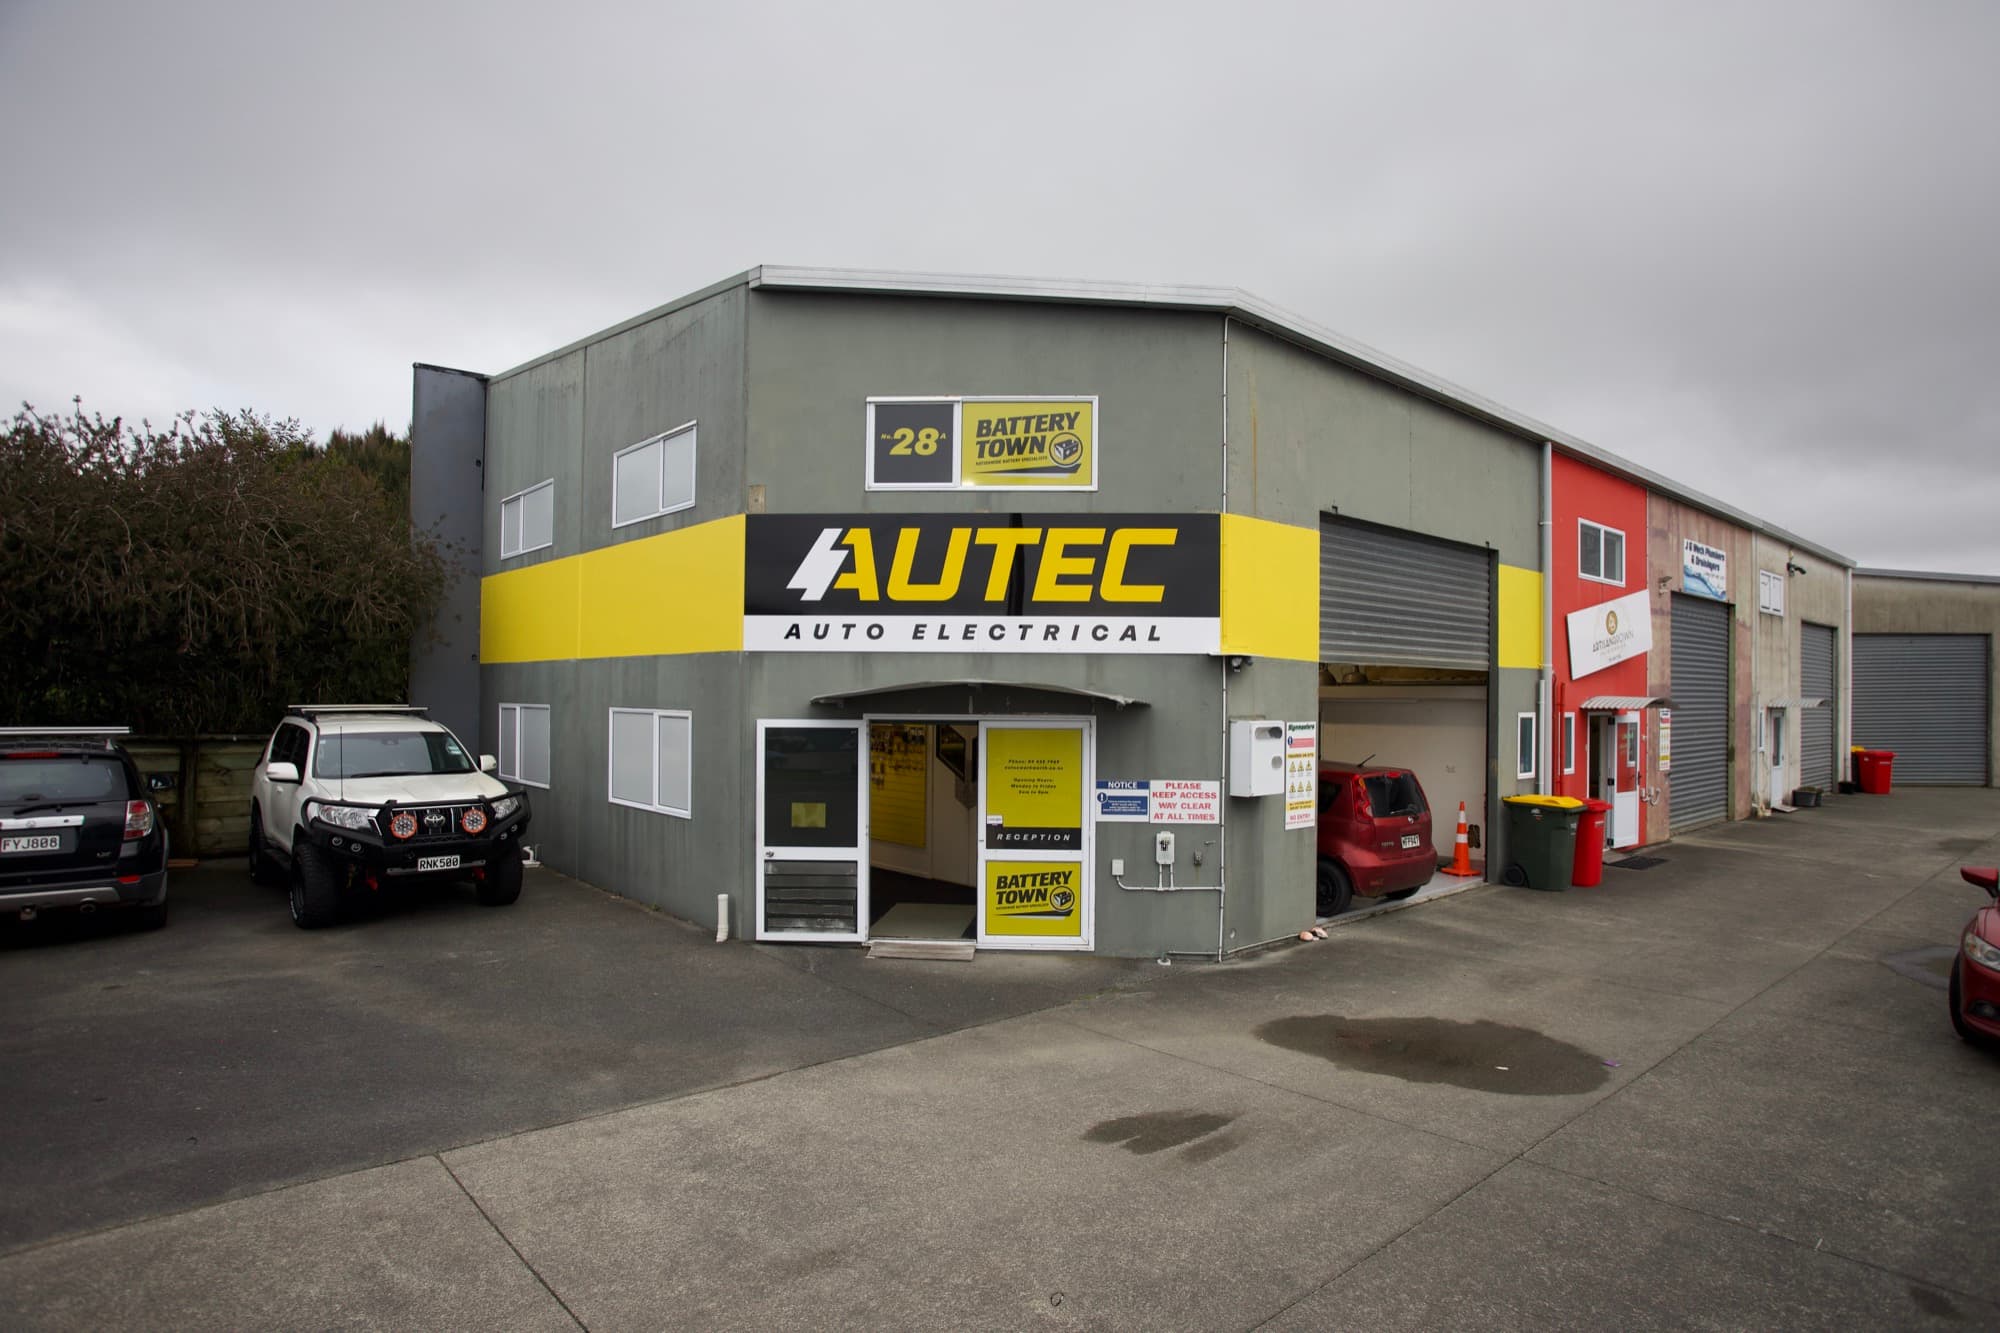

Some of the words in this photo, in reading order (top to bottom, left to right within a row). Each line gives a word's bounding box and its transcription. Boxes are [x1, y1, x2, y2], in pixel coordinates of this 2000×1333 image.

[976, 411, 1080, 438] BATTERY
[976, 436, 1046, 459] TOWN
[833, 527, 1179, 602] AUTEC
[784, 623, 885, 640] AUTO
[912, 624, 1162, 642] ELECTRICAL
[1108, 781, 1138, 790] NOTICE
[1165, 782, 1202, 790] PLEASE
[997, 833, 1071, 841] RECEPTION
[420, 857, 458, 869] RNK500
[996, 870, 1073, 889] BATTERY
[996, 888, 1048, 904] TOWN
